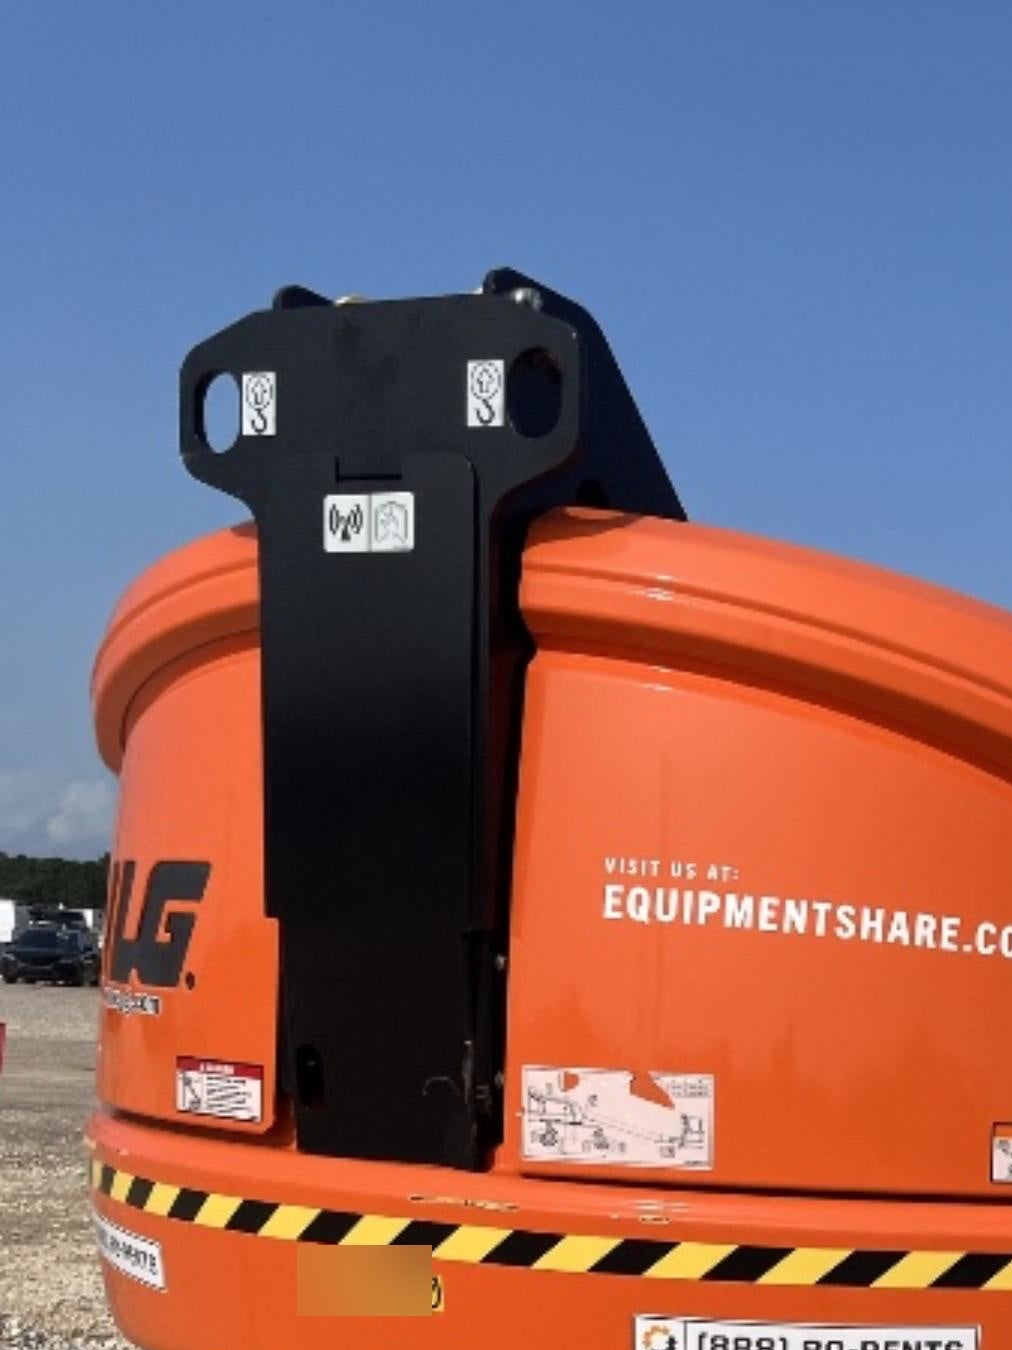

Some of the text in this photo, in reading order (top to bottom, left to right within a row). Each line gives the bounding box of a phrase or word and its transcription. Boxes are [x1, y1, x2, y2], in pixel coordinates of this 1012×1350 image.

[604, 857, 741, 882] VISIT US AT:
